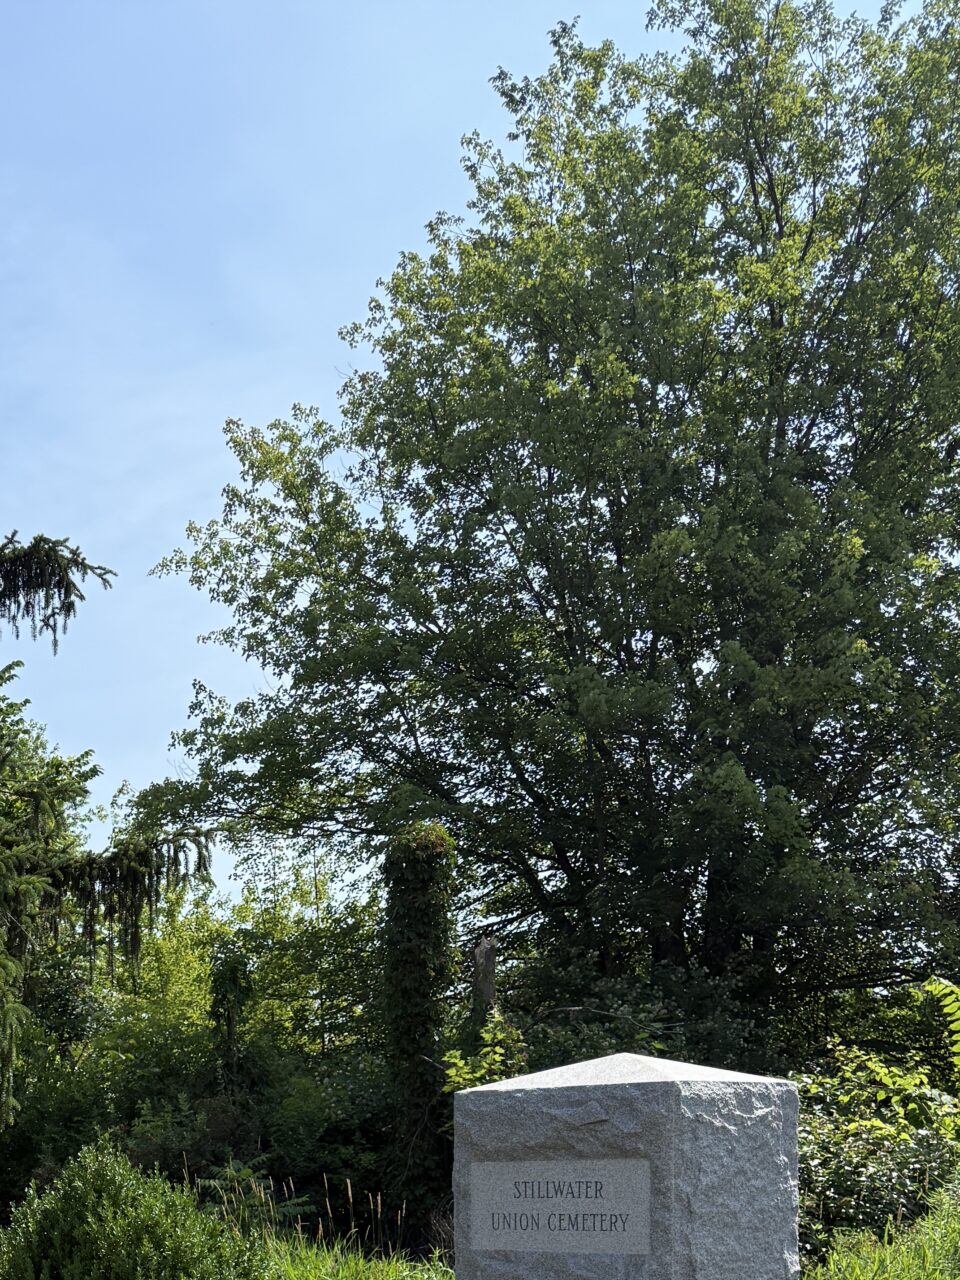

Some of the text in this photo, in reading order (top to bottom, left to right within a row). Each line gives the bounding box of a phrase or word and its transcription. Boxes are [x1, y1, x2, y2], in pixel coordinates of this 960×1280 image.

[513, 1180, 604, 1199] STILLWATER
[491, 1212, 630, 1232] UNION CEMETERY
